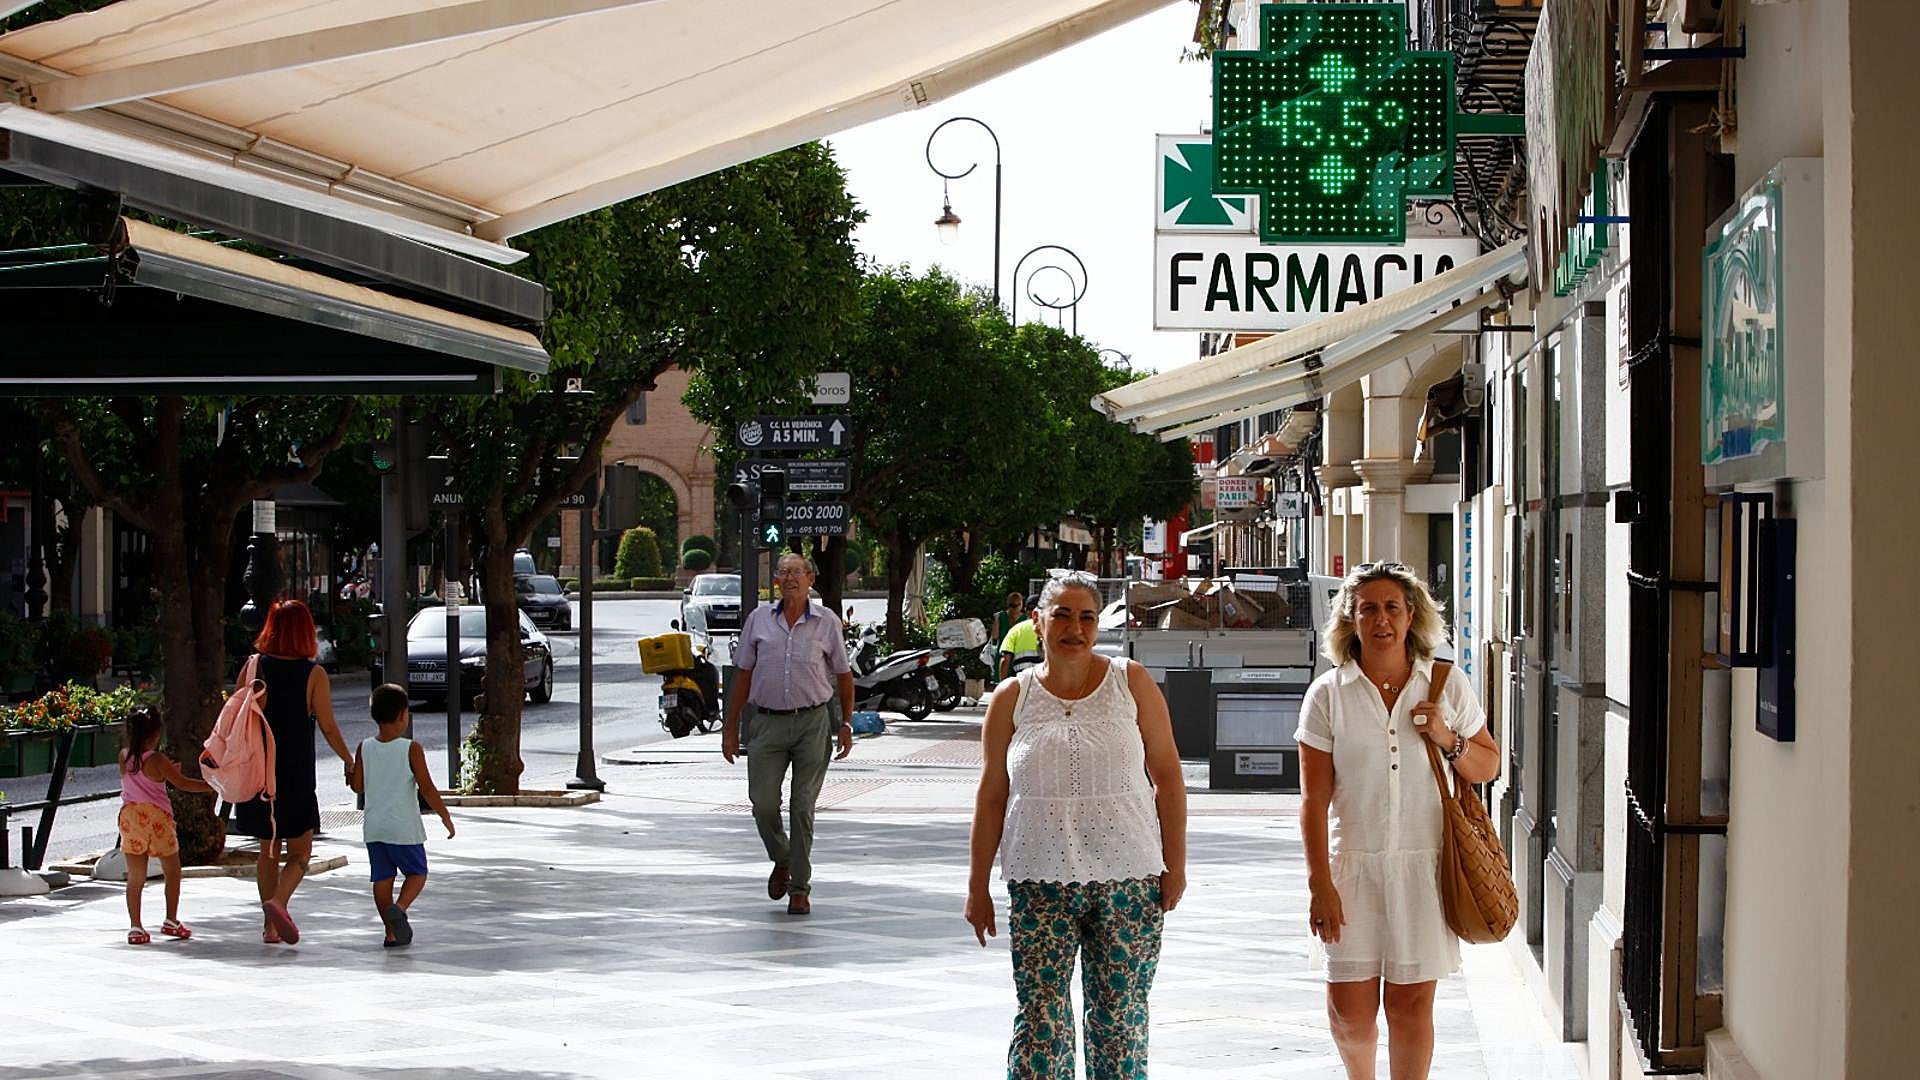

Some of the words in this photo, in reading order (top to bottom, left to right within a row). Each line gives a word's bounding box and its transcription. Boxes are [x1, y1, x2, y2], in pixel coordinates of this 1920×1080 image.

[772, 429, 781, 442] A
[783, 429, 791, 442] 5
[793, 429, 820, 442] MIN.
[1219, 492, 1248, 500] PARIS
[815, 505, 844, 519] 2000
